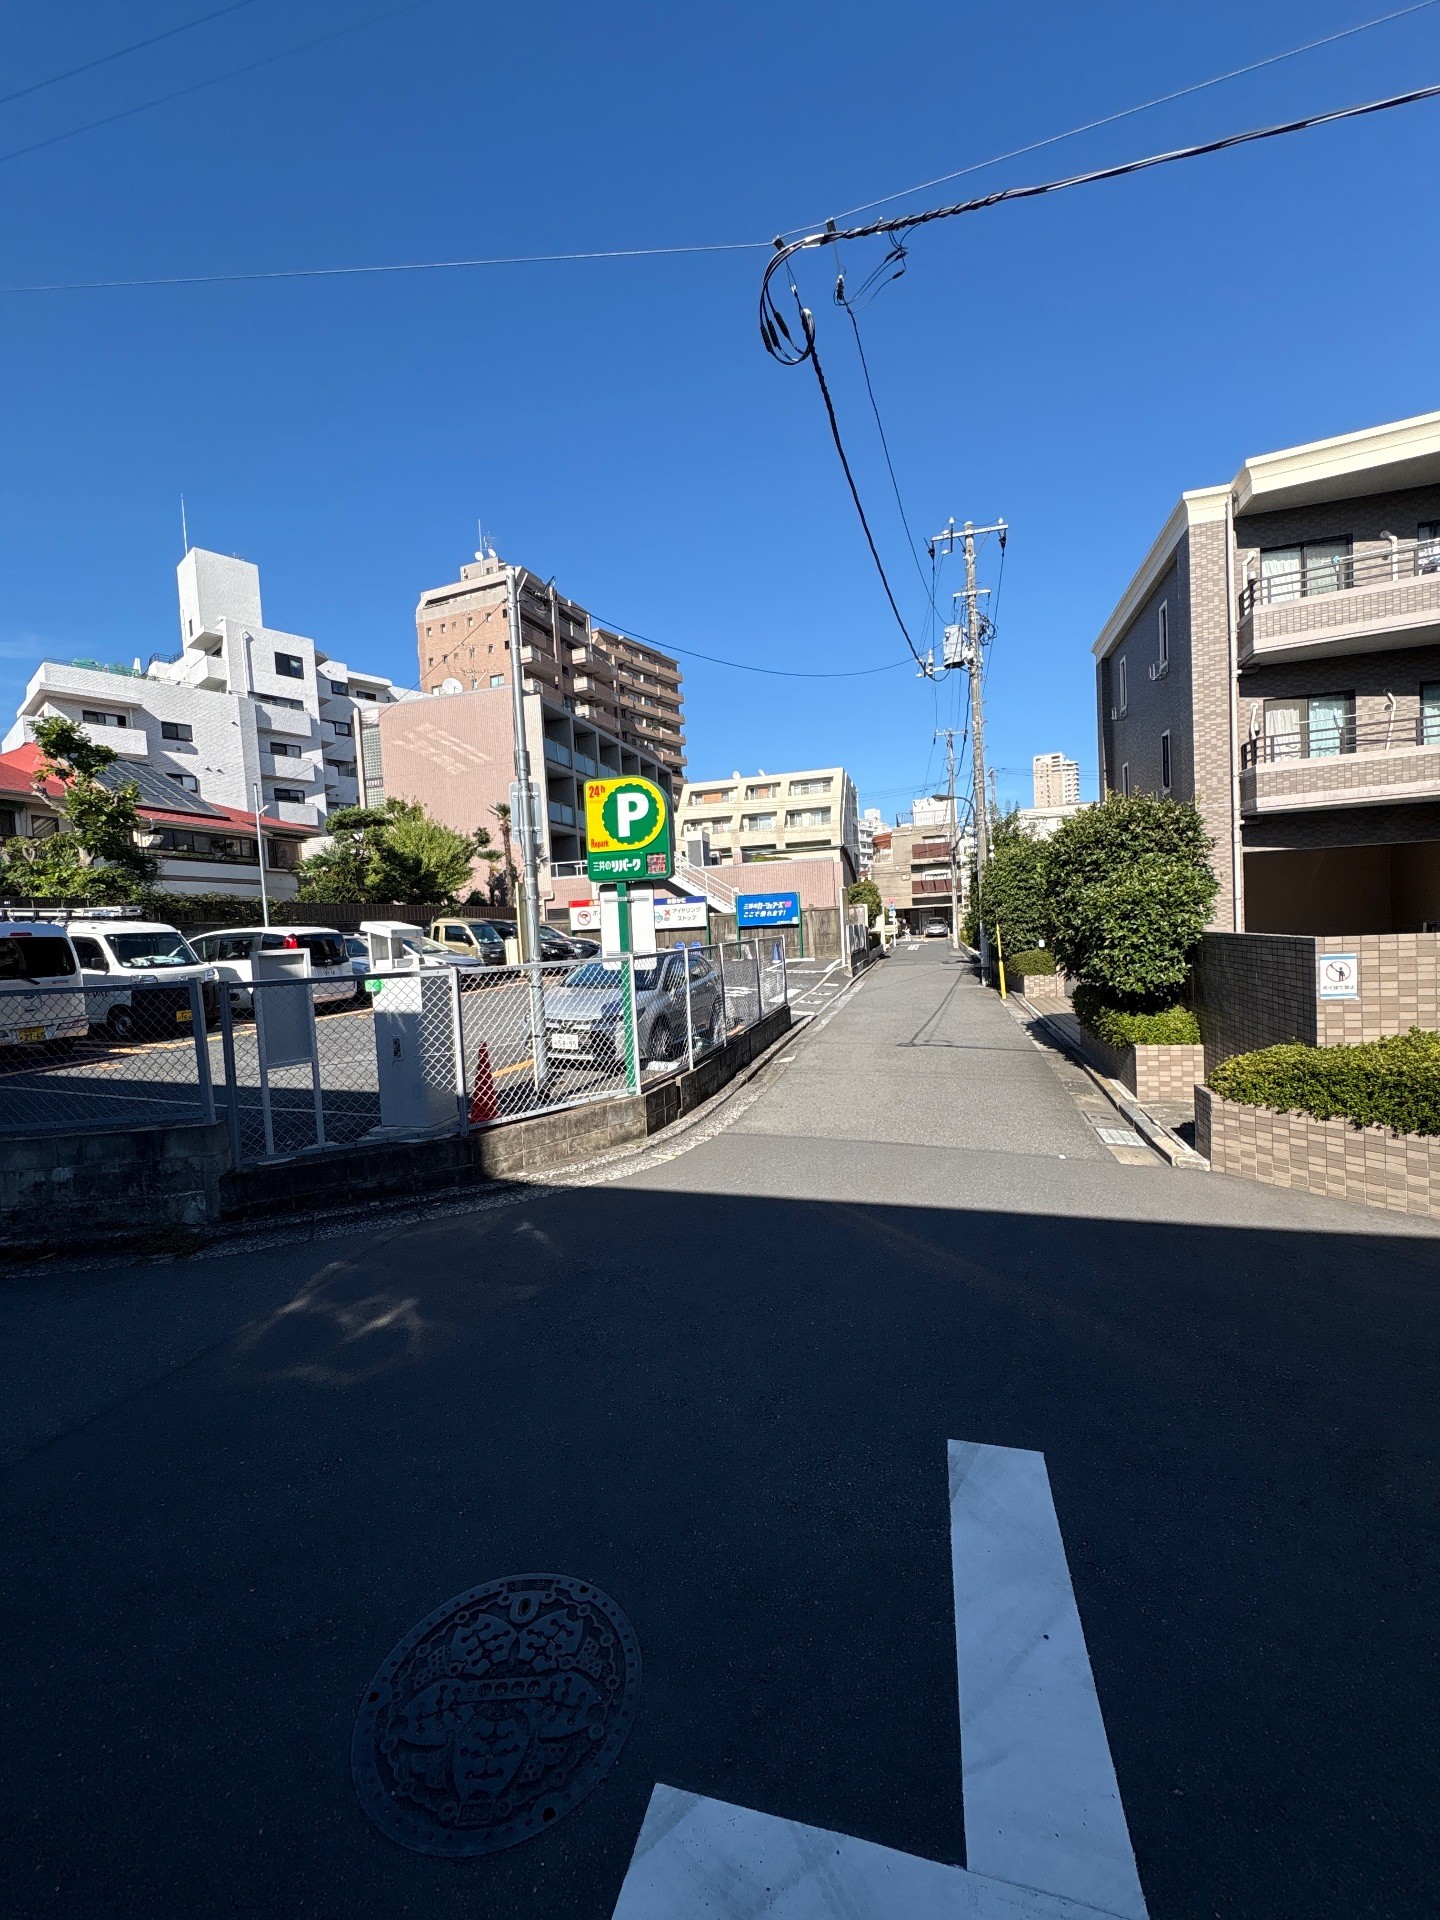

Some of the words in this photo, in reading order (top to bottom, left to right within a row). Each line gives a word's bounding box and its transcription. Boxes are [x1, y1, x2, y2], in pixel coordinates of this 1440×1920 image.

[589, 785, 606, 798] 24h
[616, 792, 649, 838] P
[591, 838, 609, 849] Repark
[593, 858, 641, 873] 三井のリパーク
[672, 906, 701, 915] アイドリング
